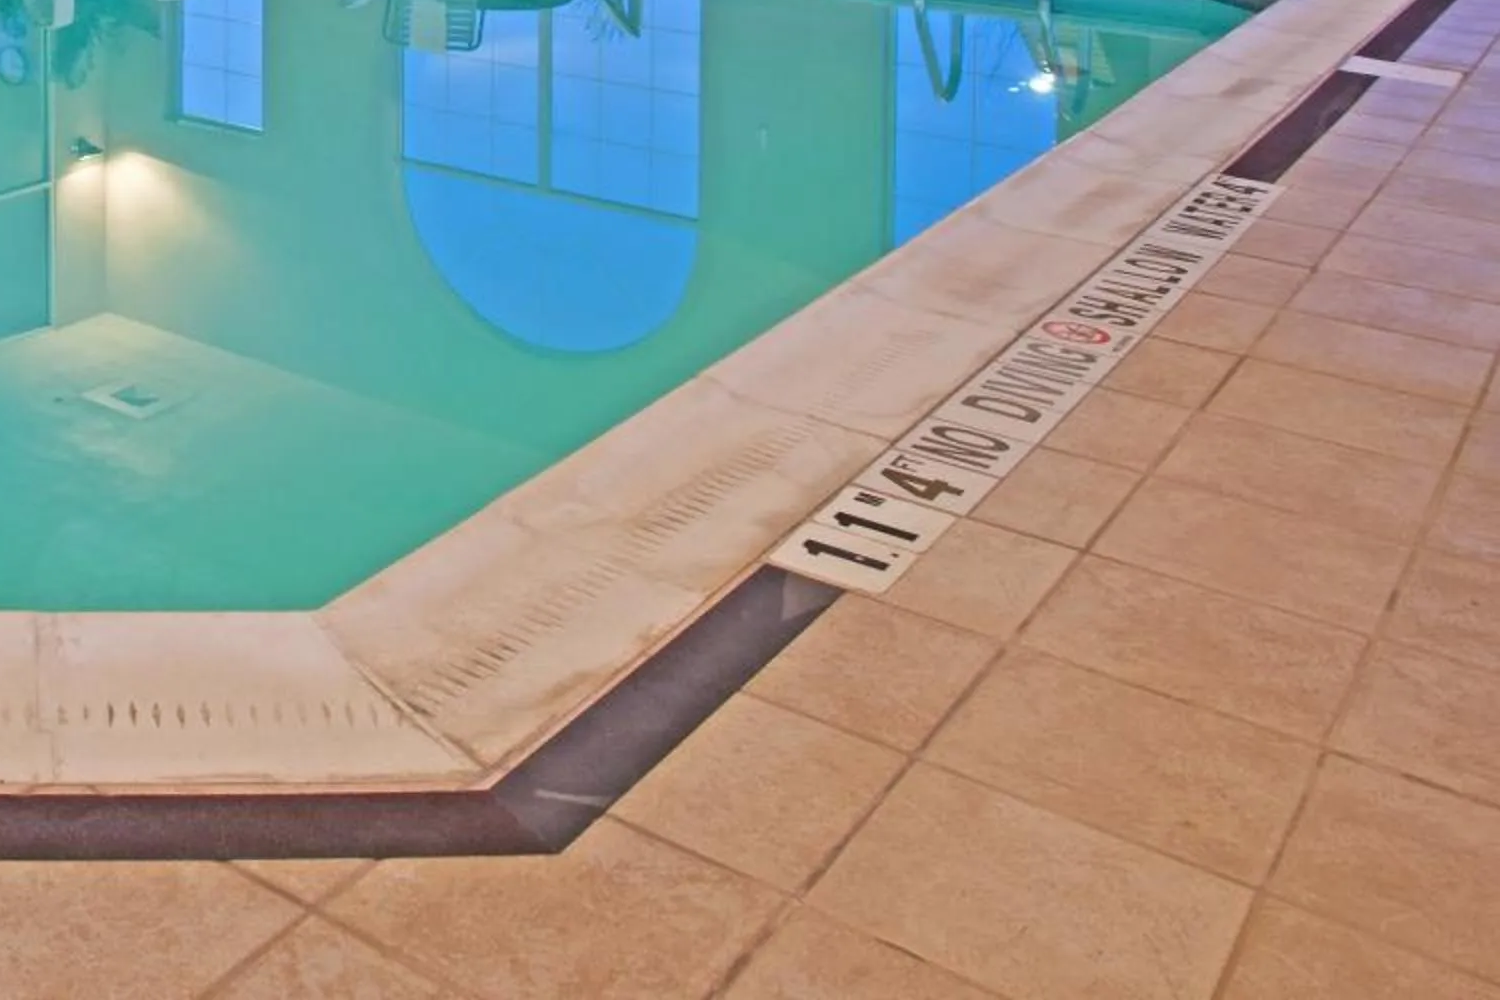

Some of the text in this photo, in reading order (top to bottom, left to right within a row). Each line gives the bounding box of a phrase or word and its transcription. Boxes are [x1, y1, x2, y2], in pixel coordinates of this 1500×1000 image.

[910, 426, 1010, 470] NO
[960, 342, 1098, 424] DIVING
[1068, 243, 1204, 328] SHALLOW
[1162, 190, 1263, 240] WATER
